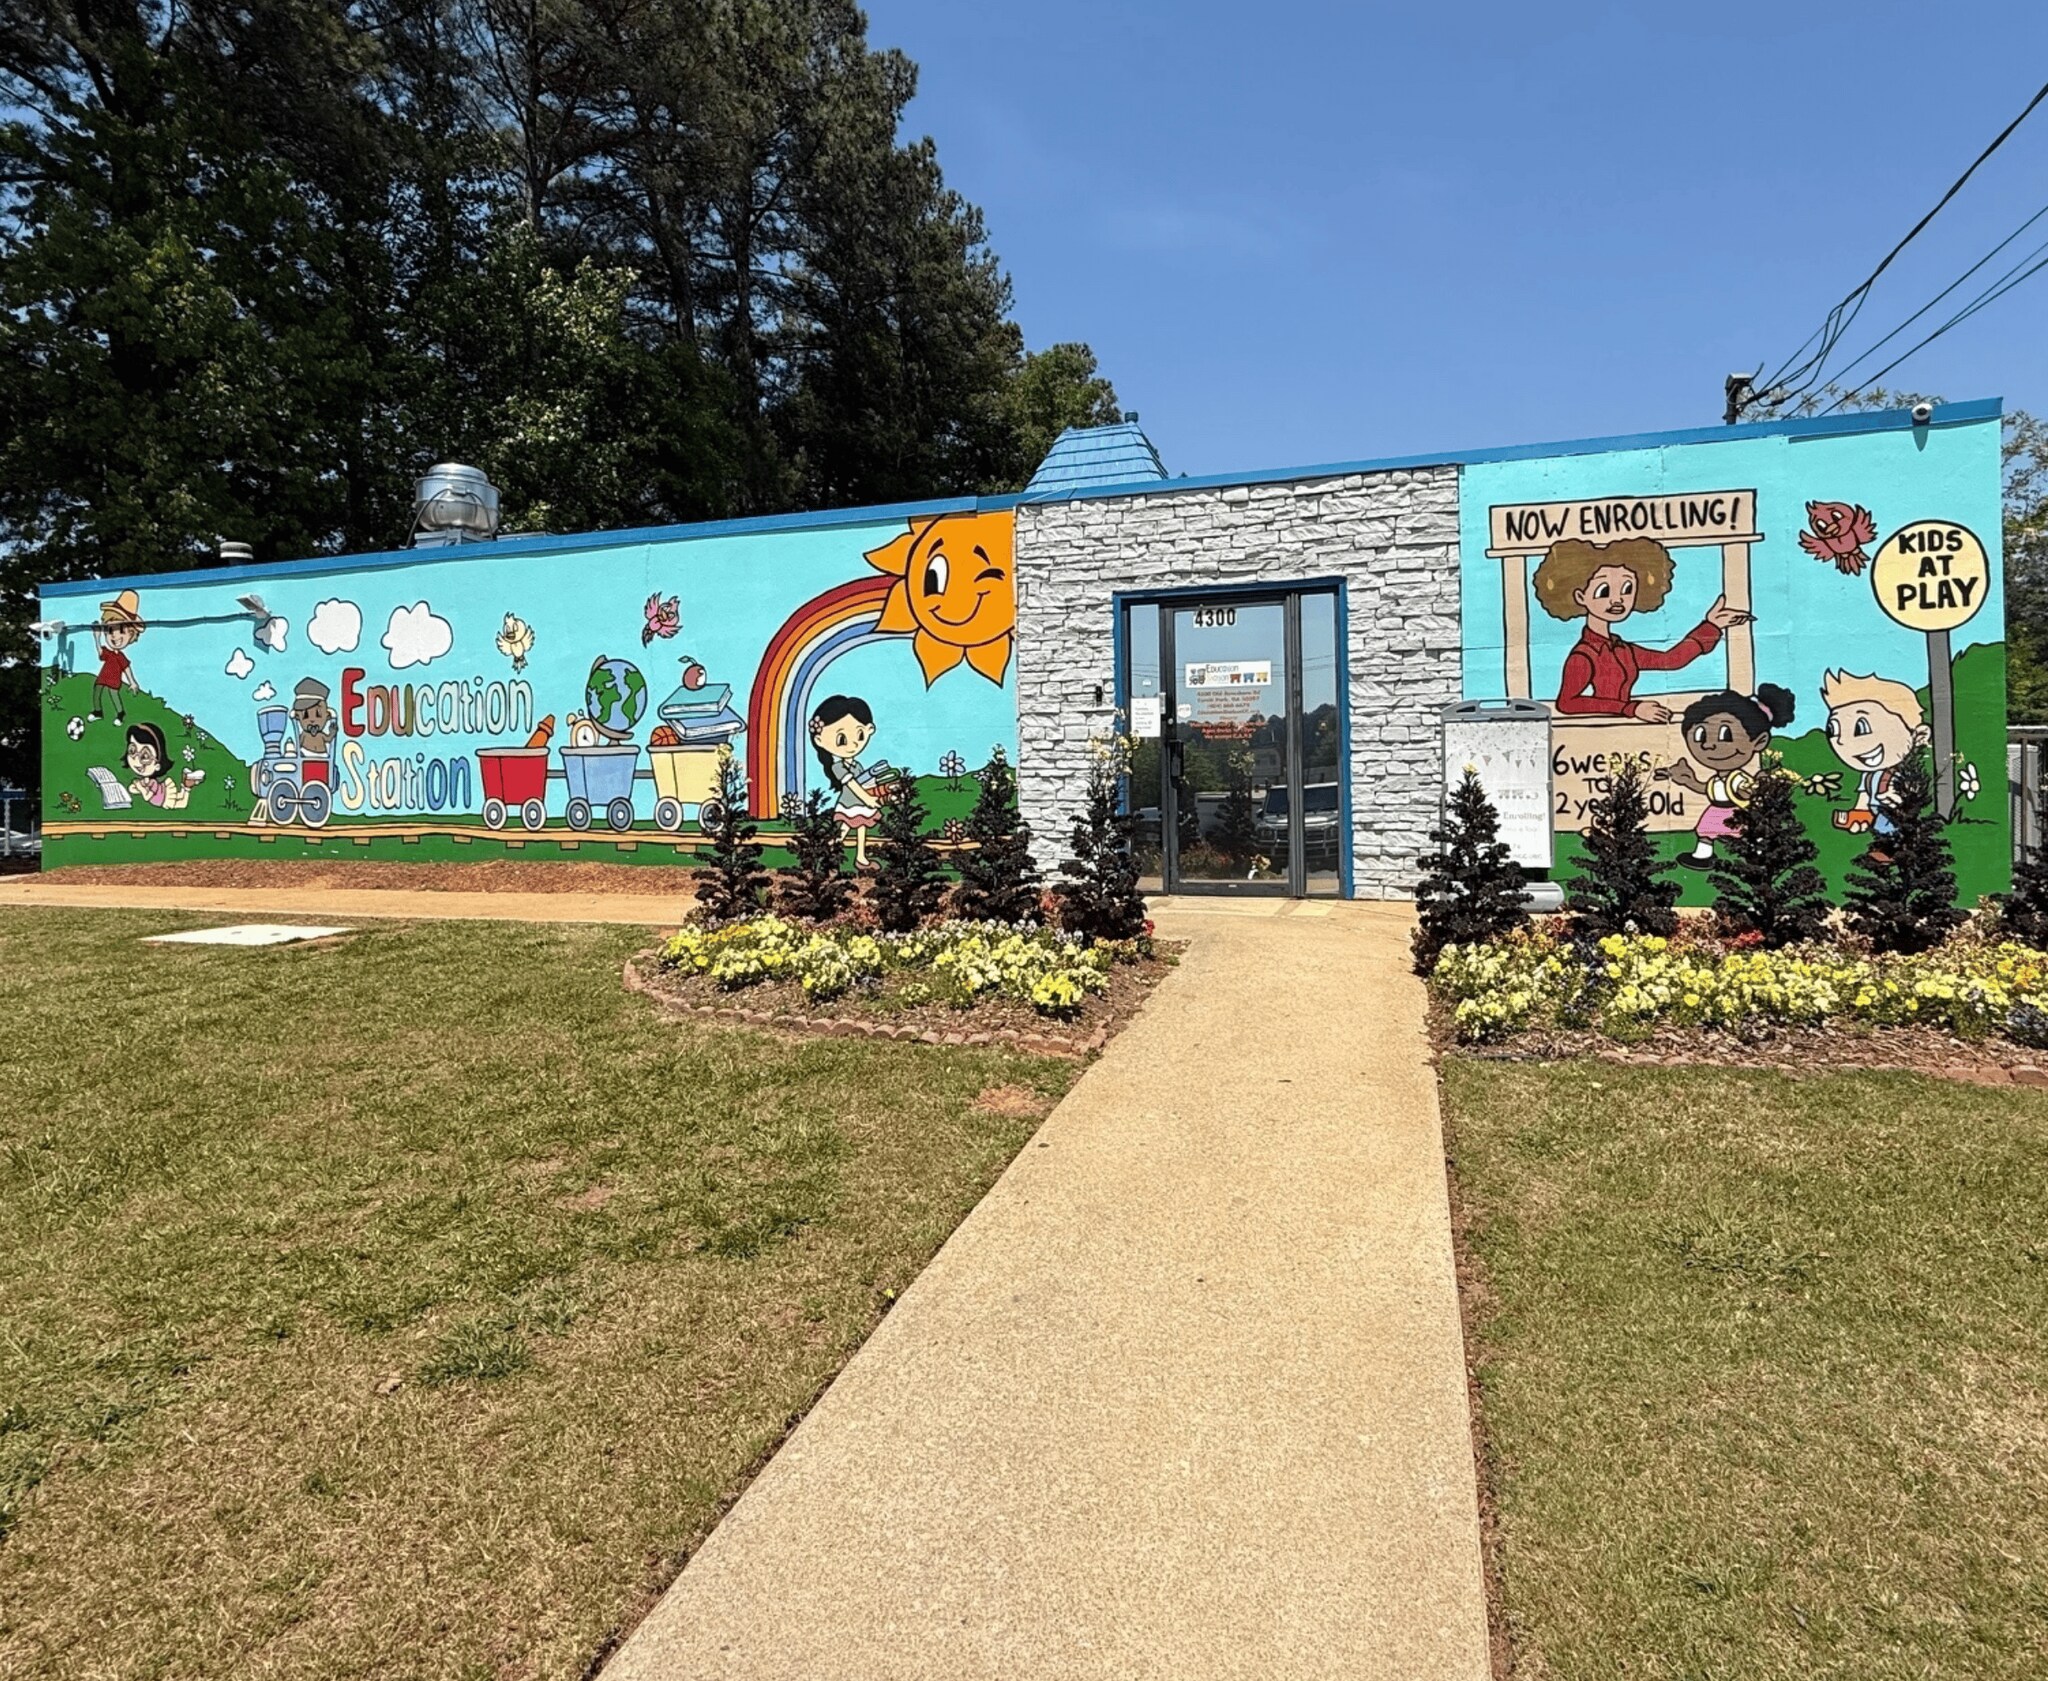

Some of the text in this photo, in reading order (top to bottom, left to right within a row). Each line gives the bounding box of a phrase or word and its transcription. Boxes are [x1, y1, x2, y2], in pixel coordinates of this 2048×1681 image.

[1506, 497, 1740, 541] NOW ENROLLING!
[1898, 529, 1963, 555] KIDS
[1918, 555, 1954, 578] AT
[1896, 577, 1979, 611] PLAY
[1195, 607, 1236, 627] 4300
[340, 740, 472, 811] Station
[1555, 792, 1571, 814] 2
[1649, 791, 1685, 816] Old
